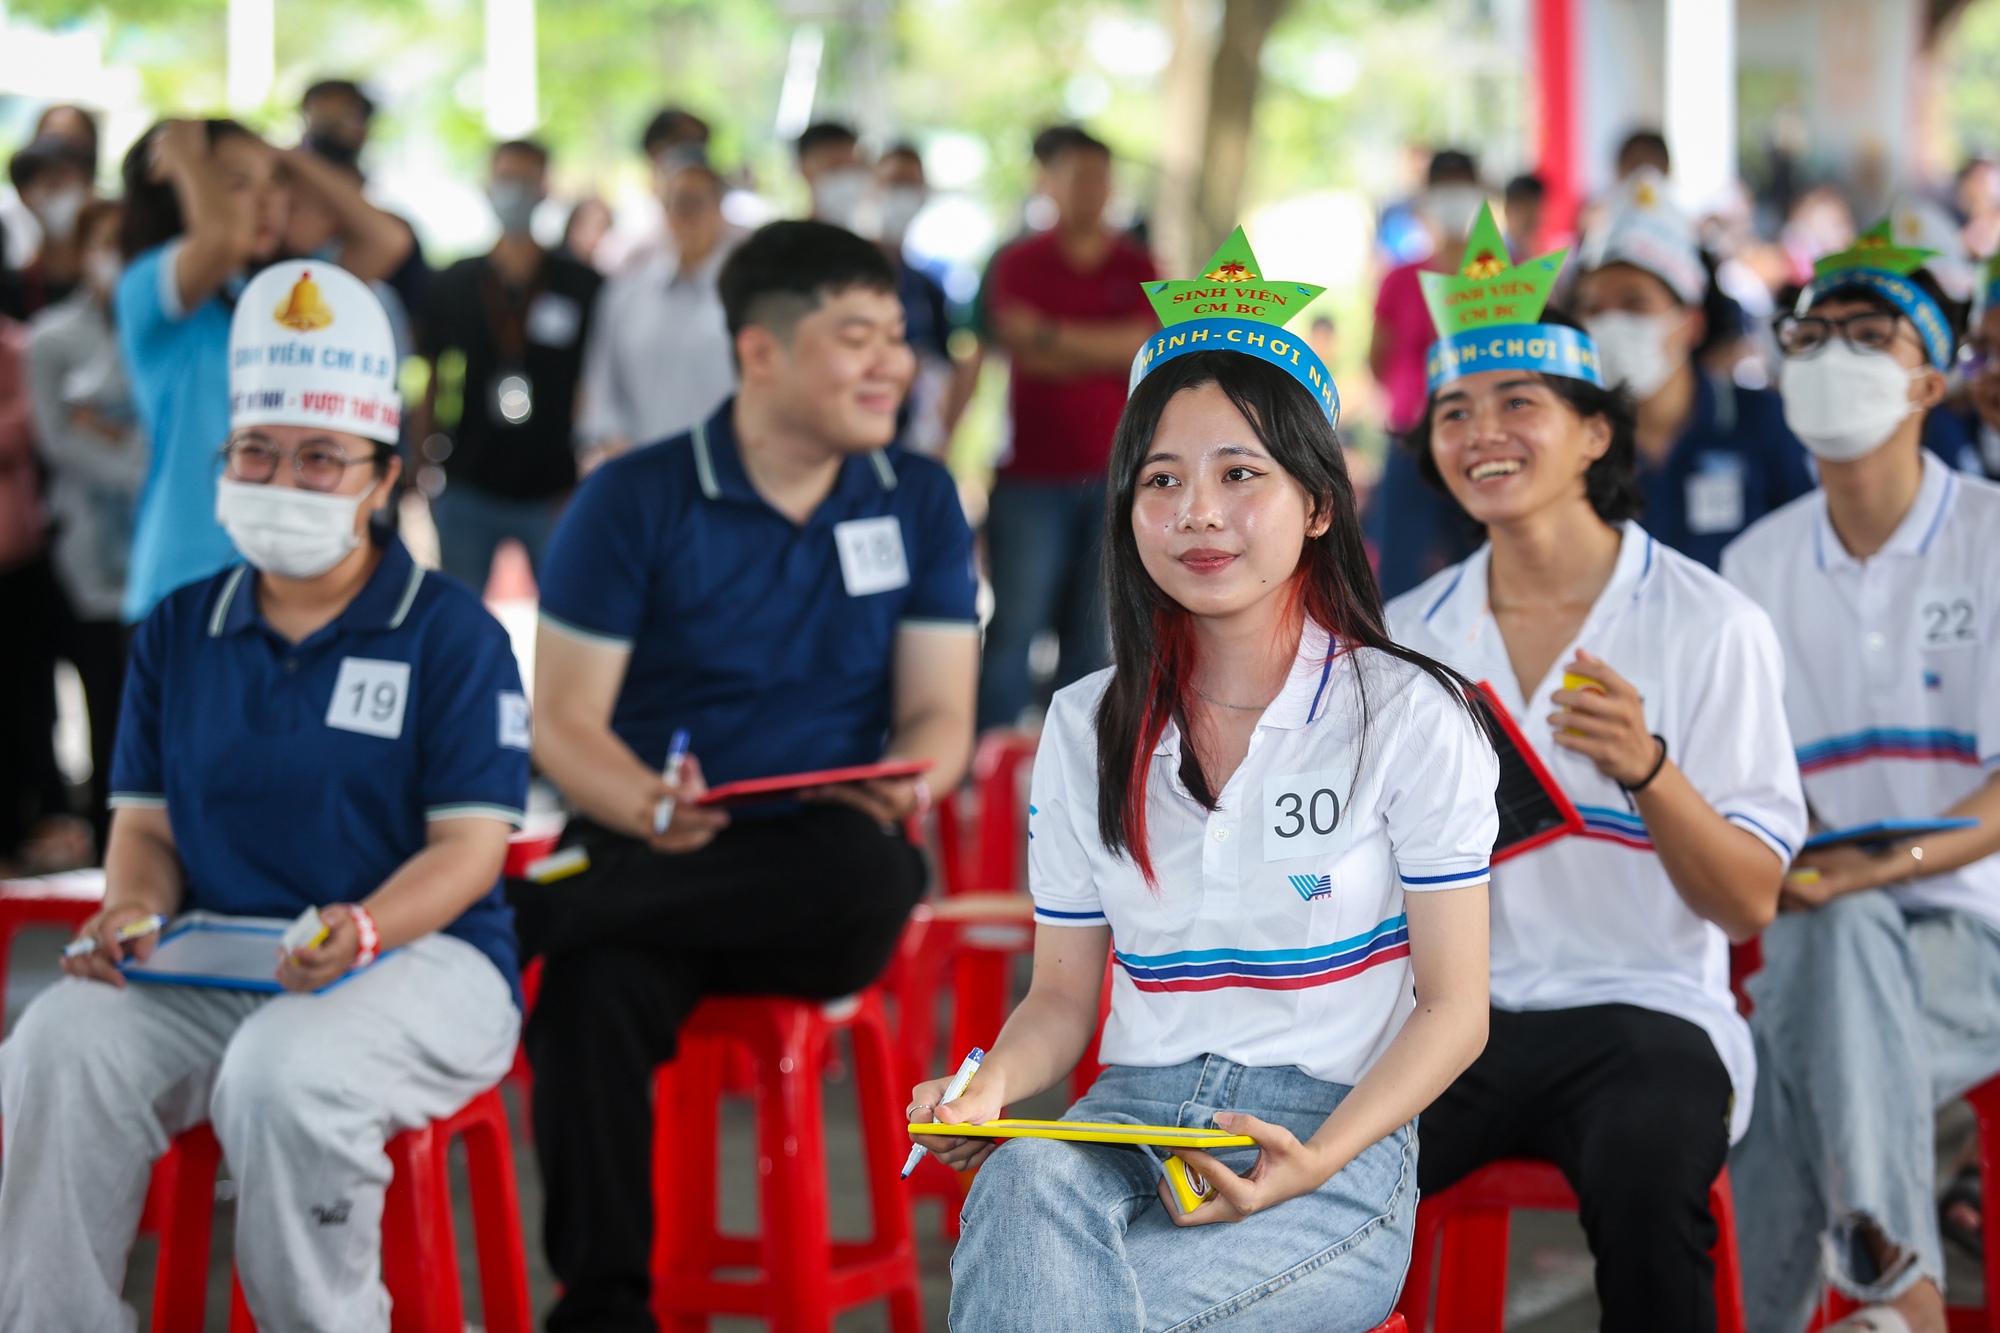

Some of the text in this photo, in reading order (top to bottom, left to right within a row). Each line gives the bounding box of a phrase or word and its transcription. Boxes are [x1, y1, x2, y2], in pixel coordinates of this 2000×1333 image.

[1172, 288, 1289, 306] SINH VIÊN
[1444, 286, 1485, 307] SINH
[1194, 303, 1266, 316] CM BC
[1459, 303, 1520, 325] CM BC
[1922, 598, 1978, 643] 22
[351, 678, 398, 723] 19
[1274, 788, 1340, 838] 30
